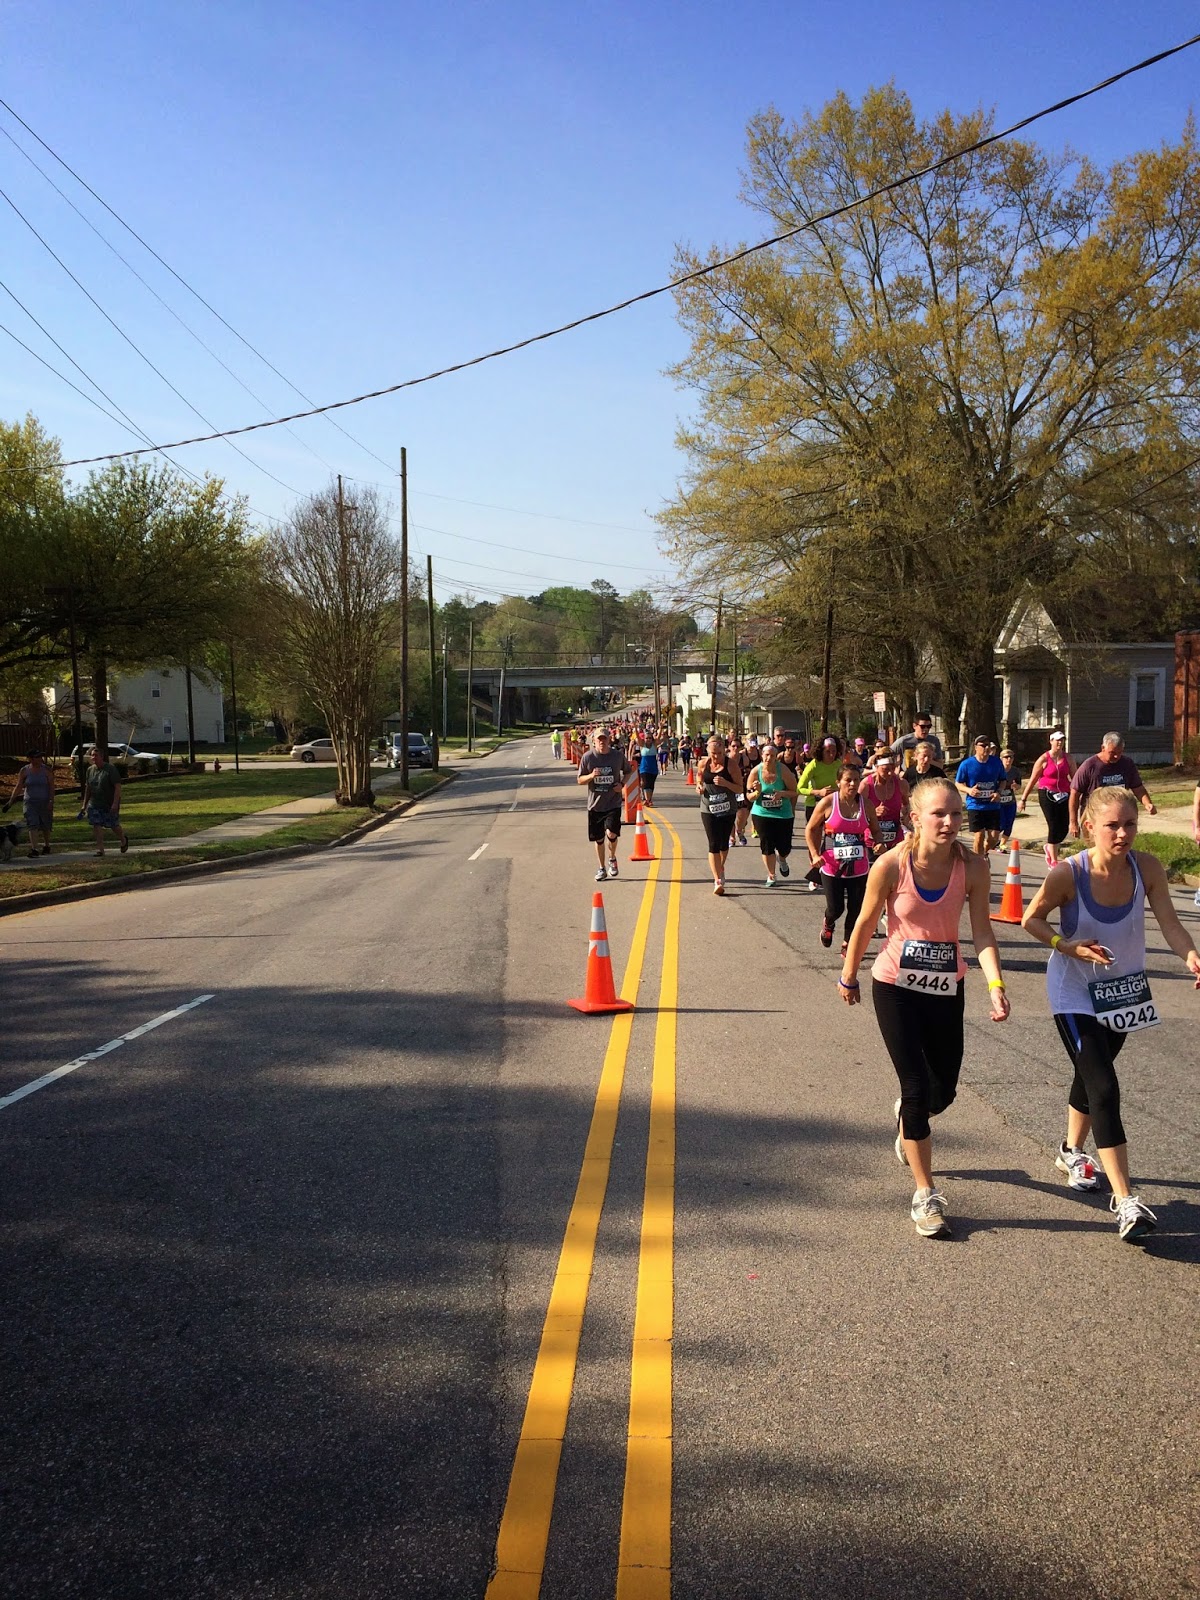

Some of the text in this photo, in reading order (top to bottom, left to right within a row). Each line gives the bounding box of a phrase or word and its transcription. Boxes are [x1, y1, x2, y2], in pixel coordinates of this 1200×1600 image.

[838, 847, 860, 857] 8120
[905, 947, 954, 960] RALEIGH
[909, 941, 932, 949] Rock
[907, 973, 950, 992] 9446
[1094, 978, 1147, 1001] RALEIGH
[1095, 980, 1119, 990] Rock
[1126, 973, 1144, 983] Roll
[1102, 1004, 1158, 1030] 10242
